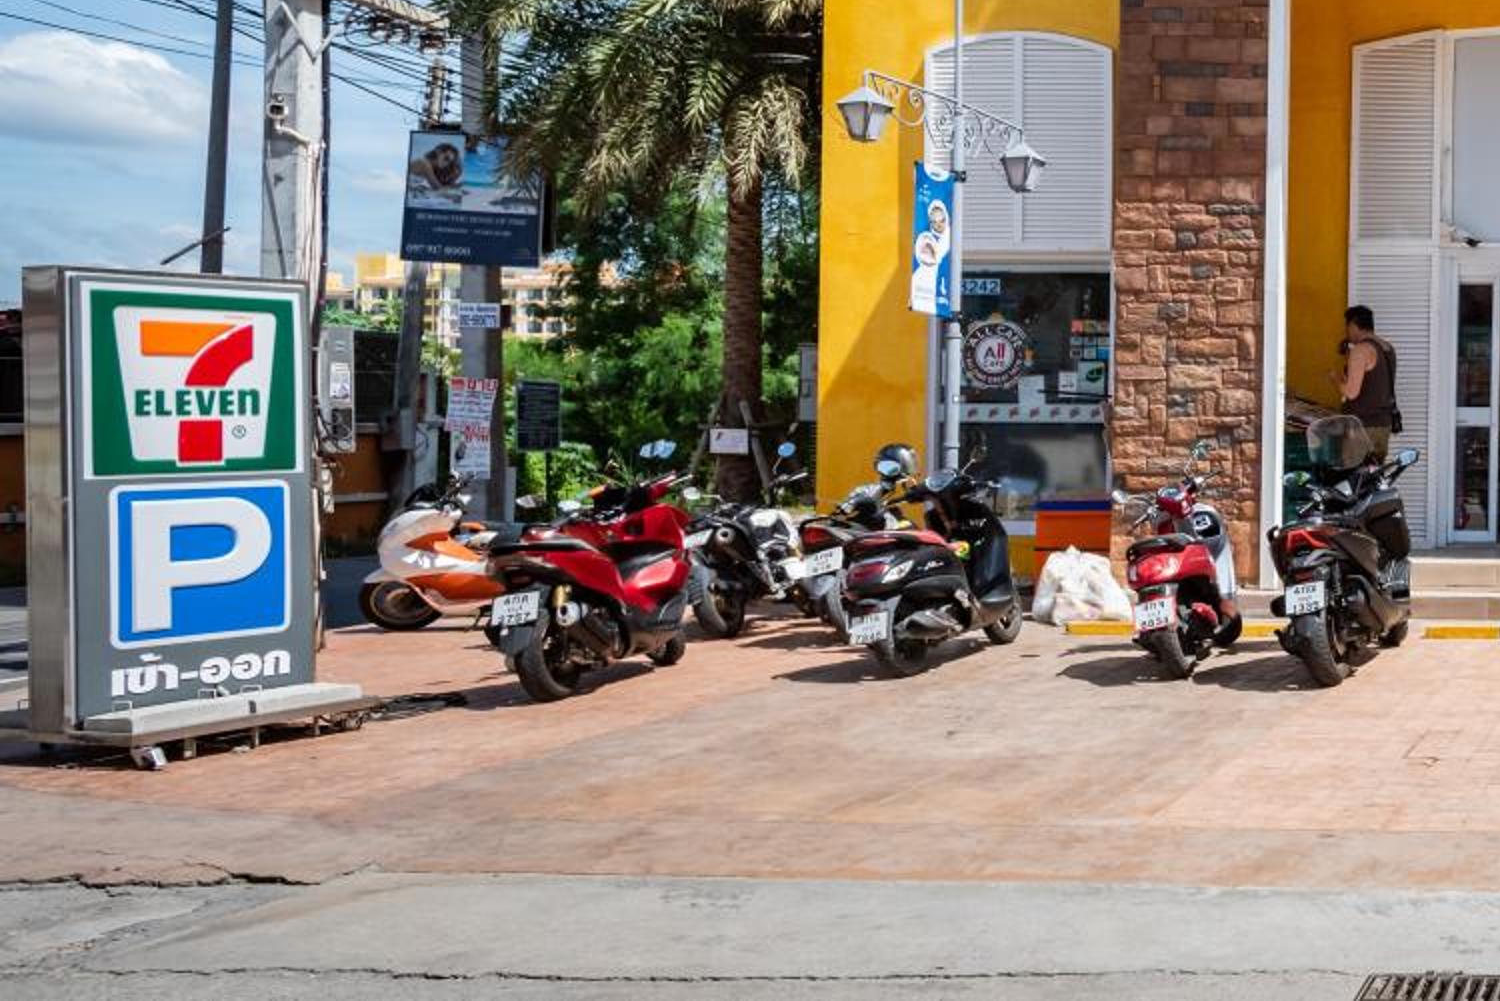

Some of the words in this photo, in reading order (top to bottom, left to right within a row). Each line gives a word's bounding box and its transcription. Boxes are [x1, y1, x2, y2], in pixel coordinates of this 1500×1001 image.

[139, 321, 254, 463] 7
[131, 497, 273, 633] P
[111, 650, 292, 697] เข้า-ออก
